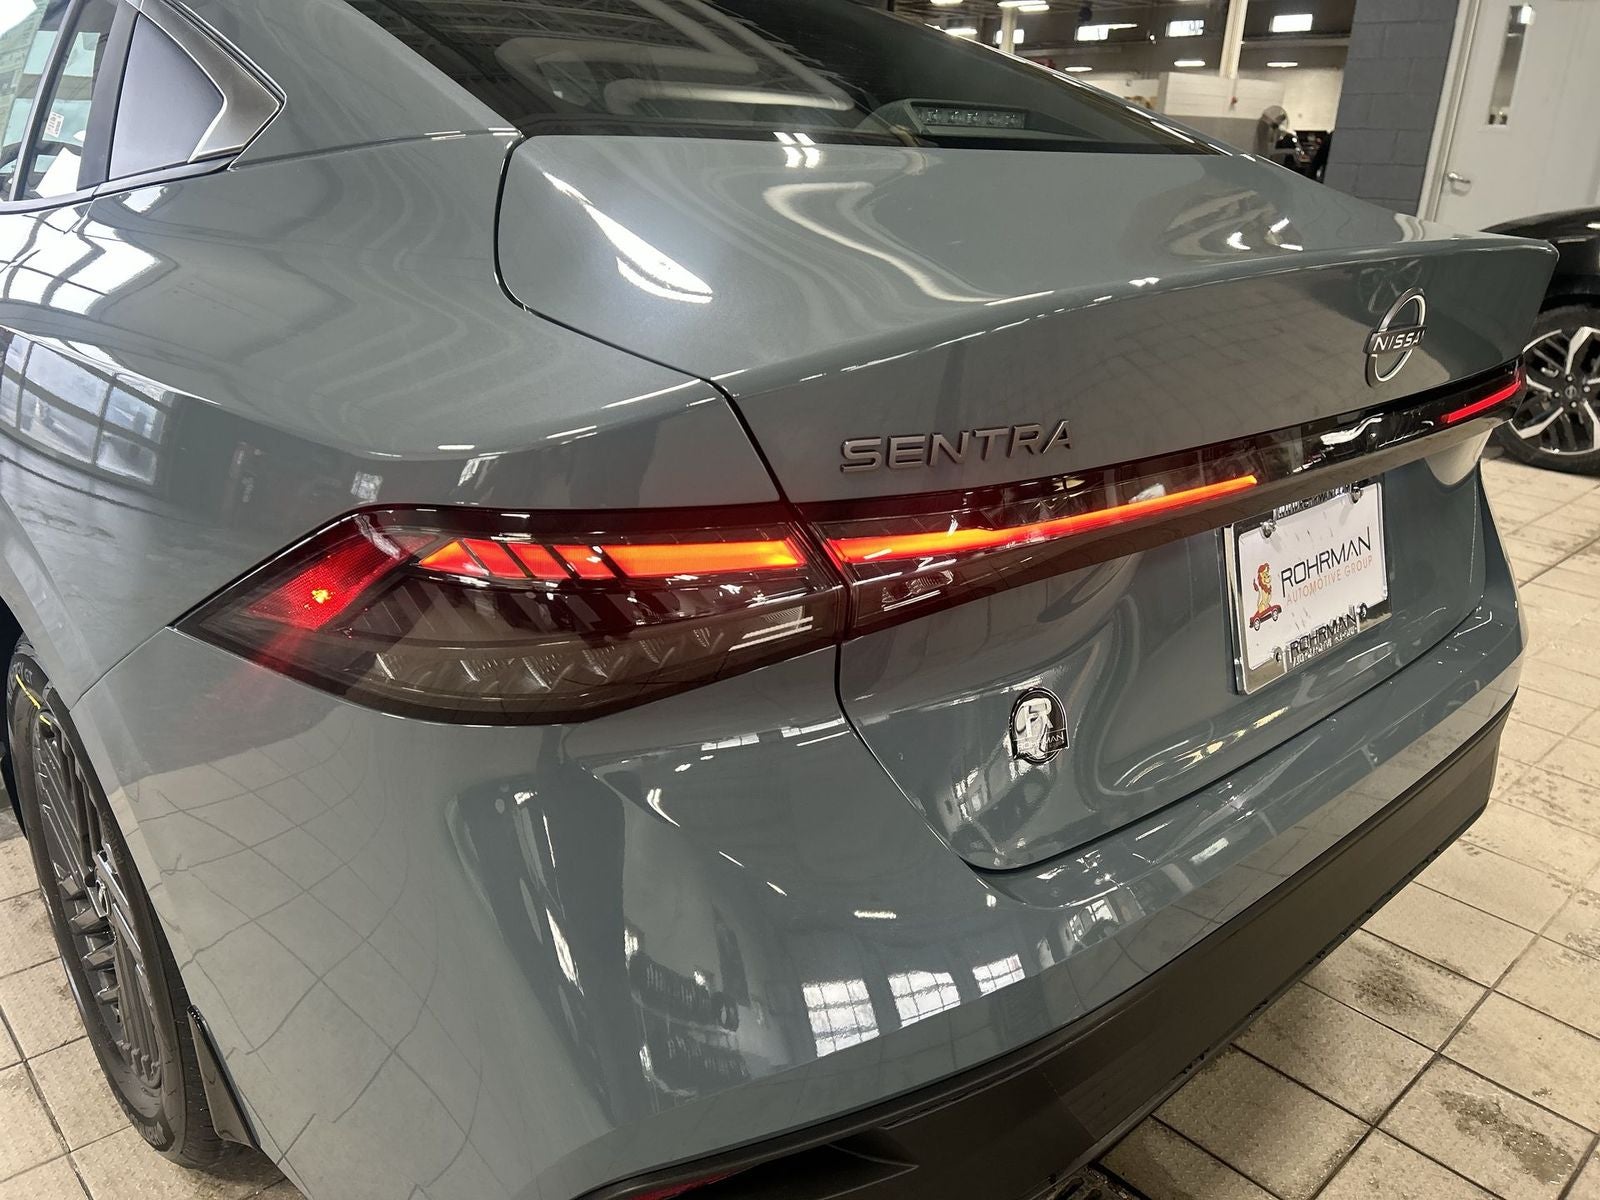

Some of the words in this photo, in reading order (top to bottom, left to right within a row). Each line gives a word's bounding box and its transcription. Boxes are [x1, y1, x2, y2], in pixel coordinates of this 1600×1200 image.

[1373, 330, 1426, 352] NISSA
[839, 418, 1073, 473] SENTRA
[1280, 526, 1371, 598] ROHRMAN
[1286, 569, 1342, 605] AUTOMOTIVE
[1344, 555, 1373, 577] GROUP
[1290, 605, 1358, 662] ROHRMAN
